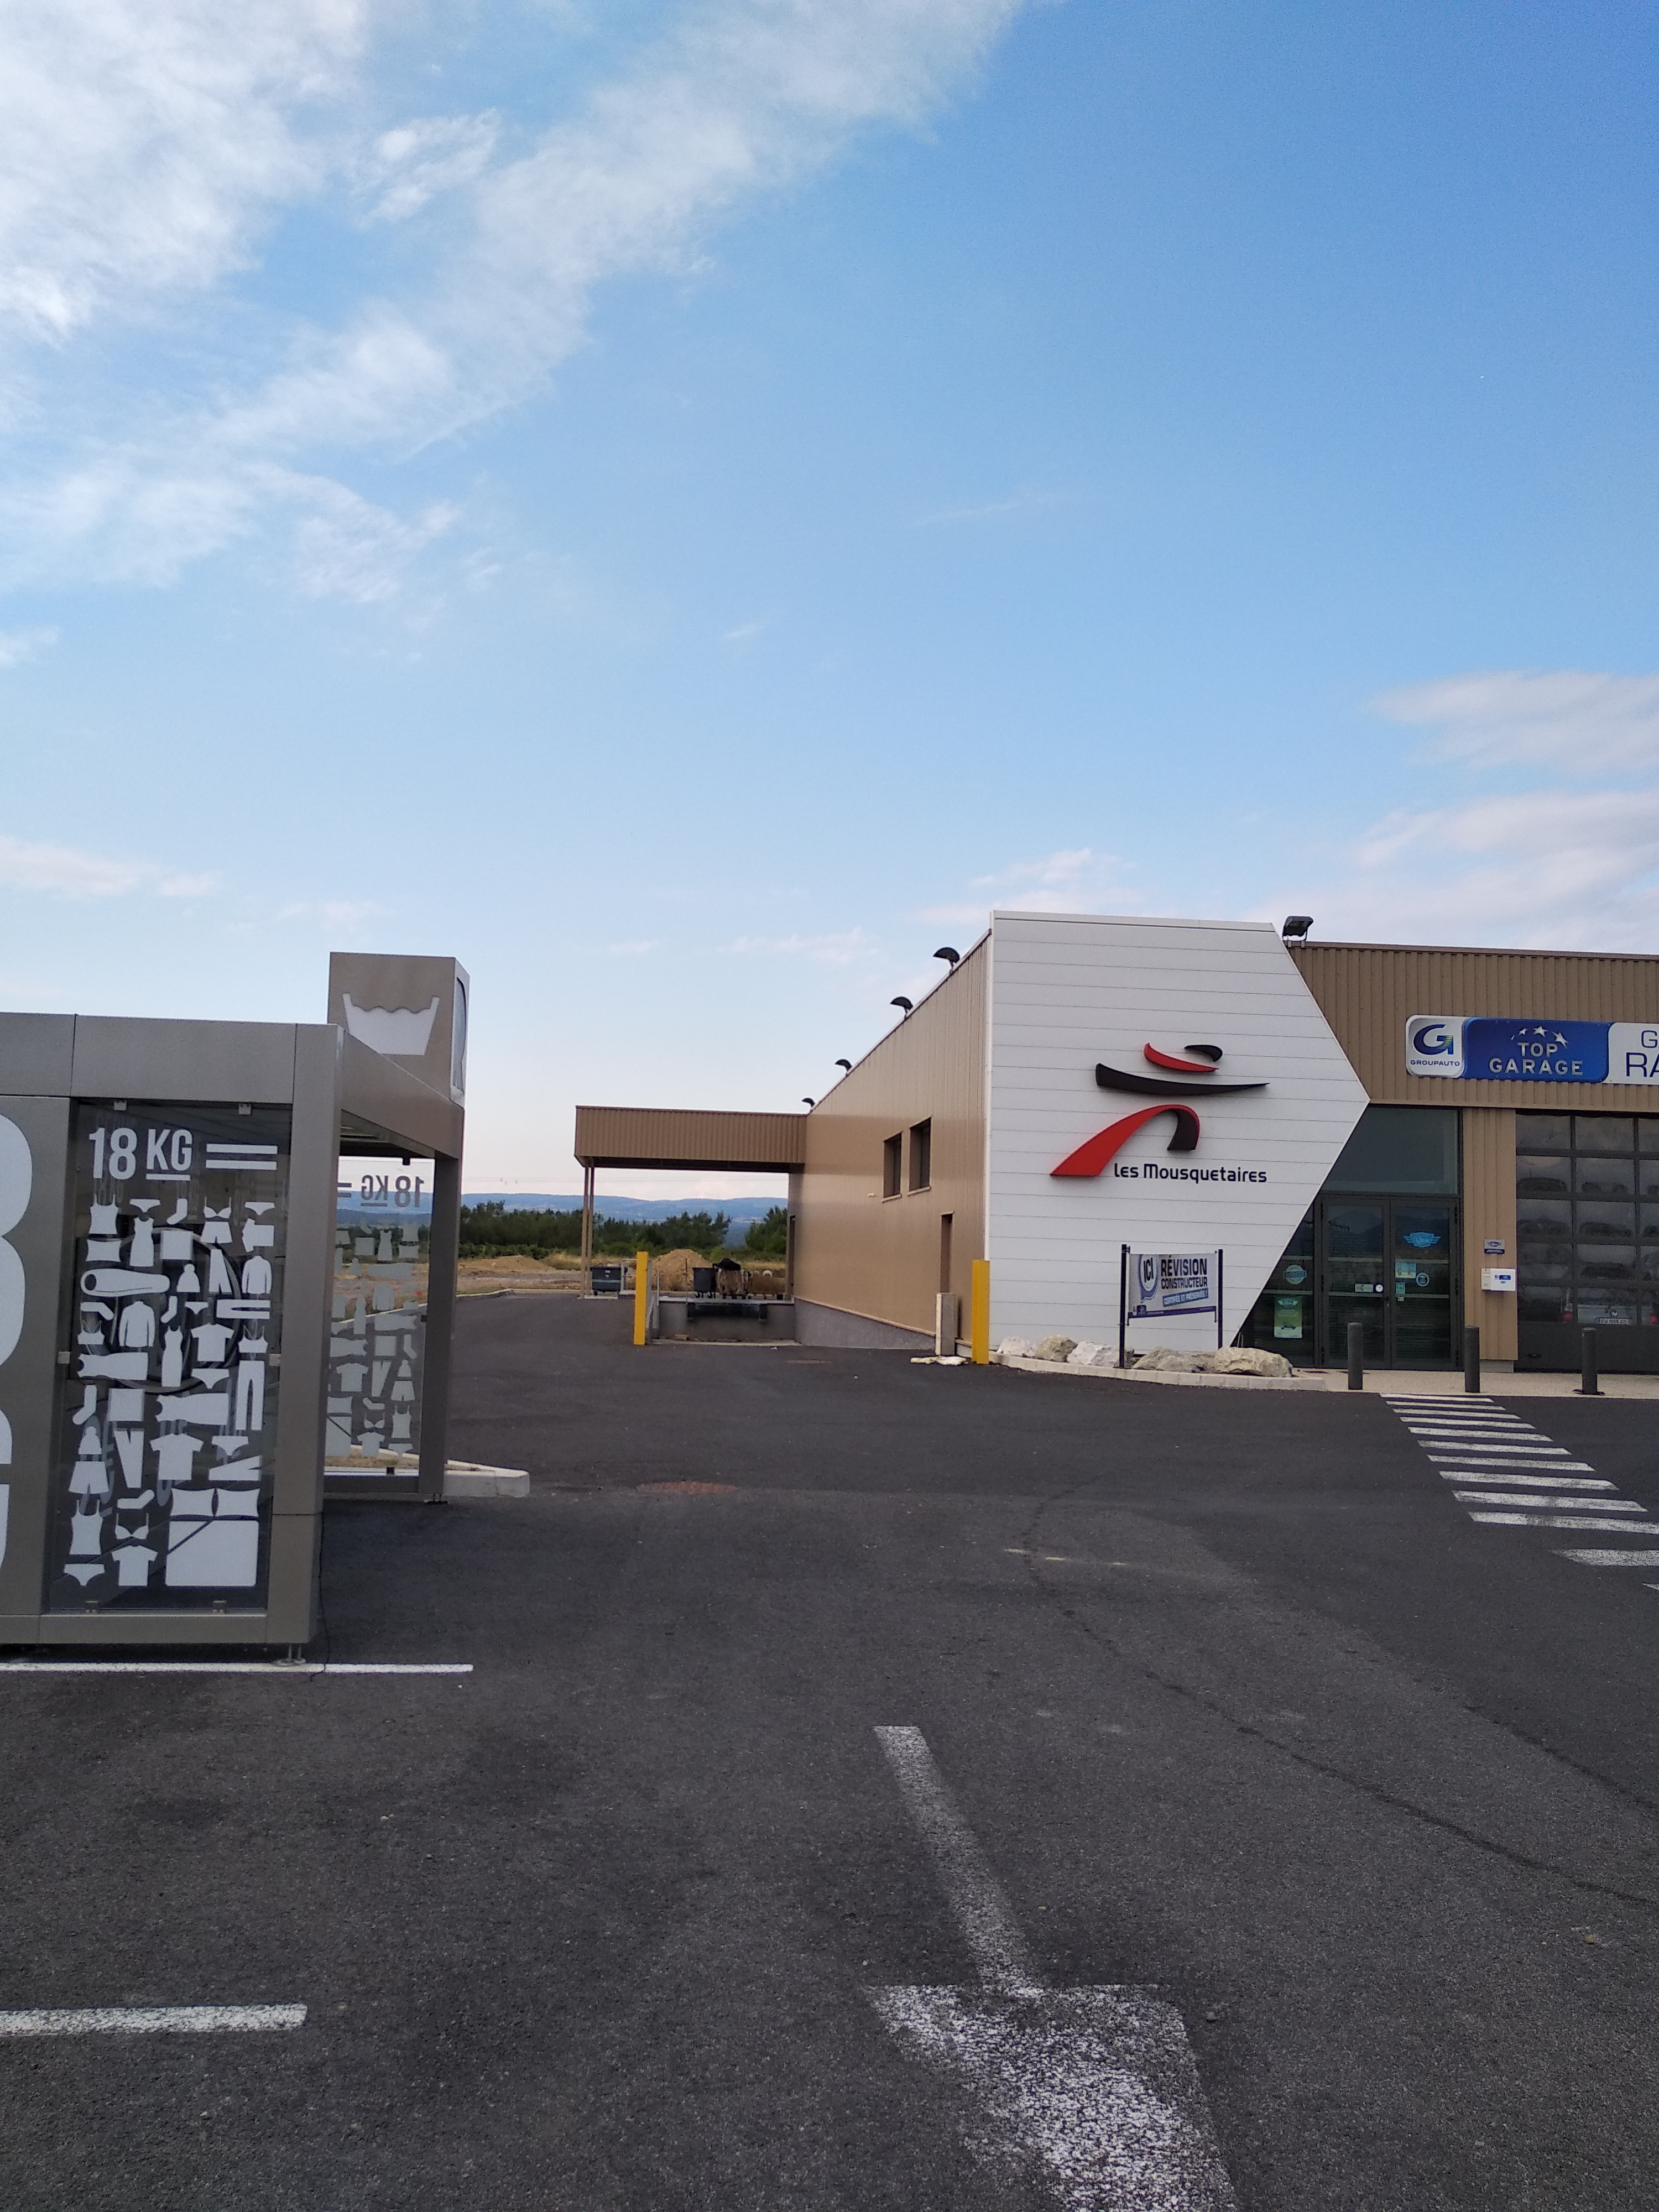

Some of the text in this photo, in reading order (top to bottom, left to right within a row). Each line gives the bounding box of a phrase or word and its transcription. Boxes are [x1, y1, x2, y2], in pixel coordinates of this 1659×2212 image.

[1517, 1042, 1558, 1057] TOP
[1489, 1058, 1583, 1076] GARAGE
[88, 1127, 138, 1180] 18
[146, 1129, 192, 1171] KG
[1144, 1164, 1267, 1184] Mousquetaires
[1143, 1257, 1154, 1283] ICI
[1161, 1255, 1207, 1277] RÉVISION
[1161, 1277, 1208, 1290] CONSTRUCTEUR
